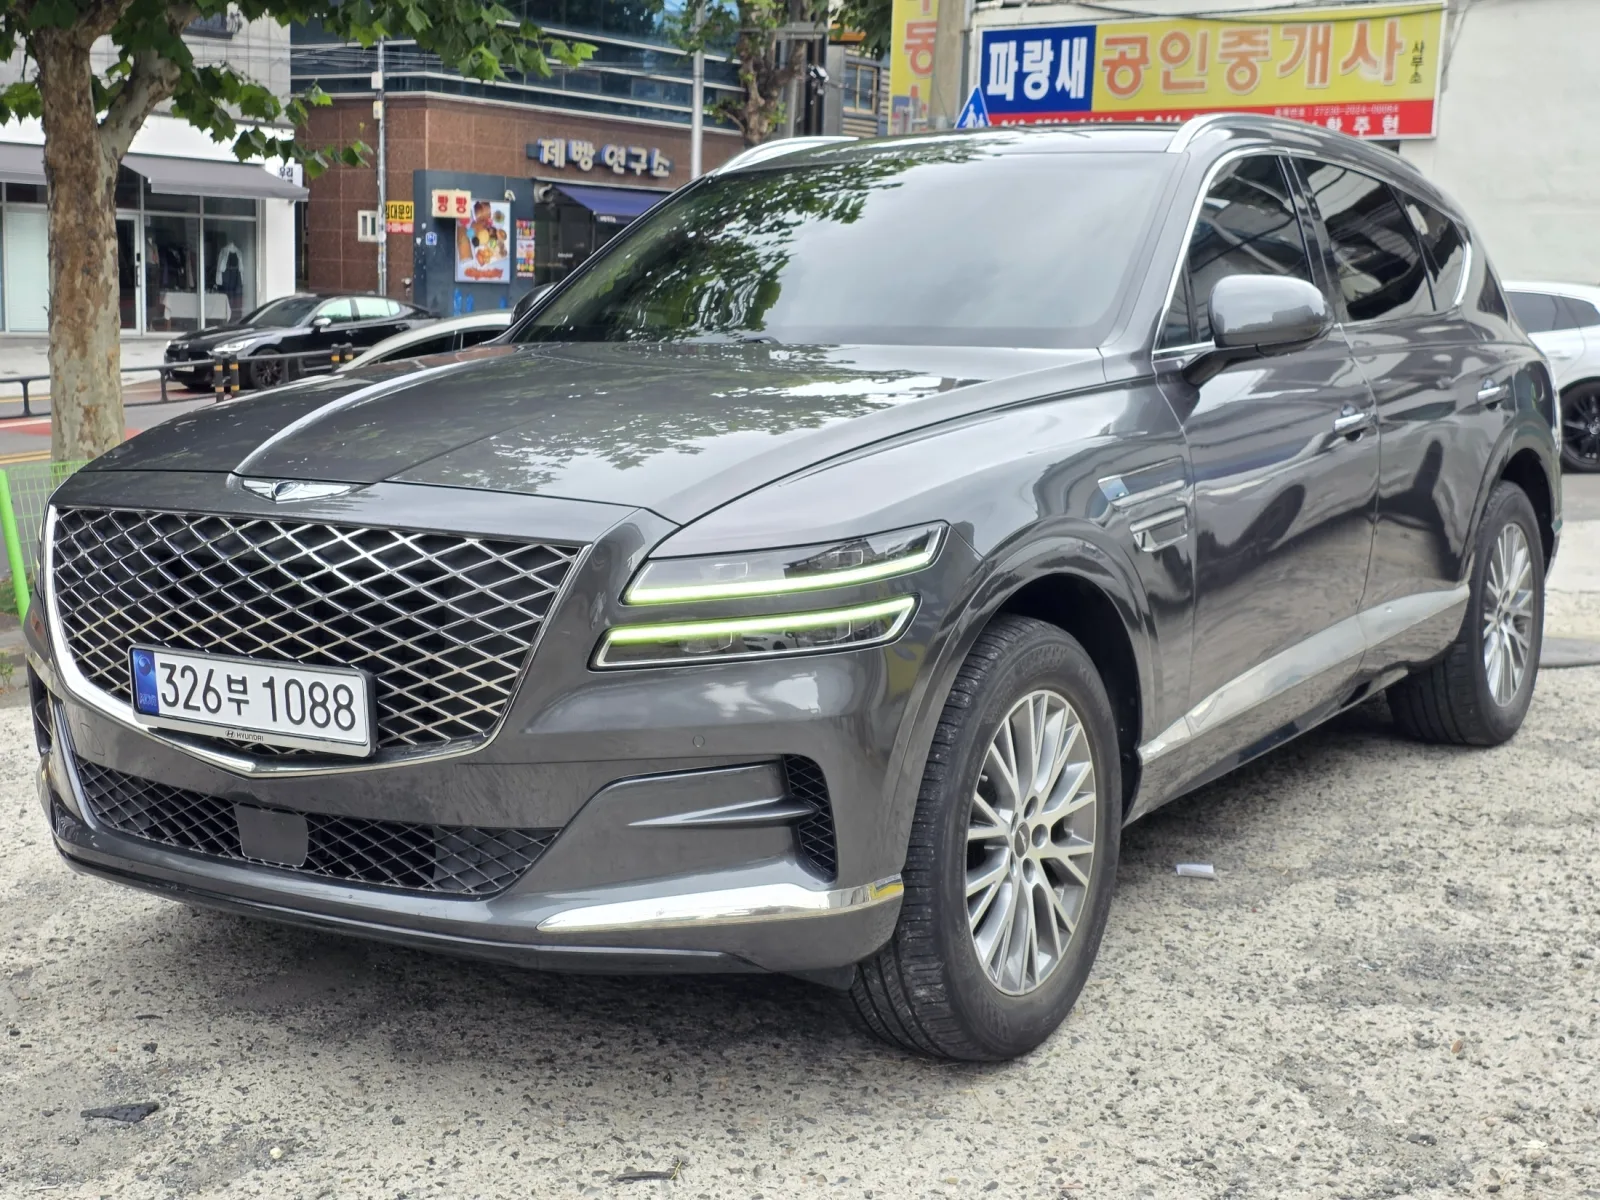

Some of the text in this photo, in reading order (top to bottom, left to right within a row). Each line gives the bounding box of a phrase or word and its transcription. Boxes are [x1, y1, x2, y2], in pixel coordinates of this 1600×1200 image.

[986, 20, 1404, 101] 파랑새 공인중개사
[1409, 40, 1425, 84] 사무소
[538, 138, 671, 177] 제빵 연구소
[160, 662, 356, 732] 326부 1088
[236, 732, 264, 741] HYUNDAI
